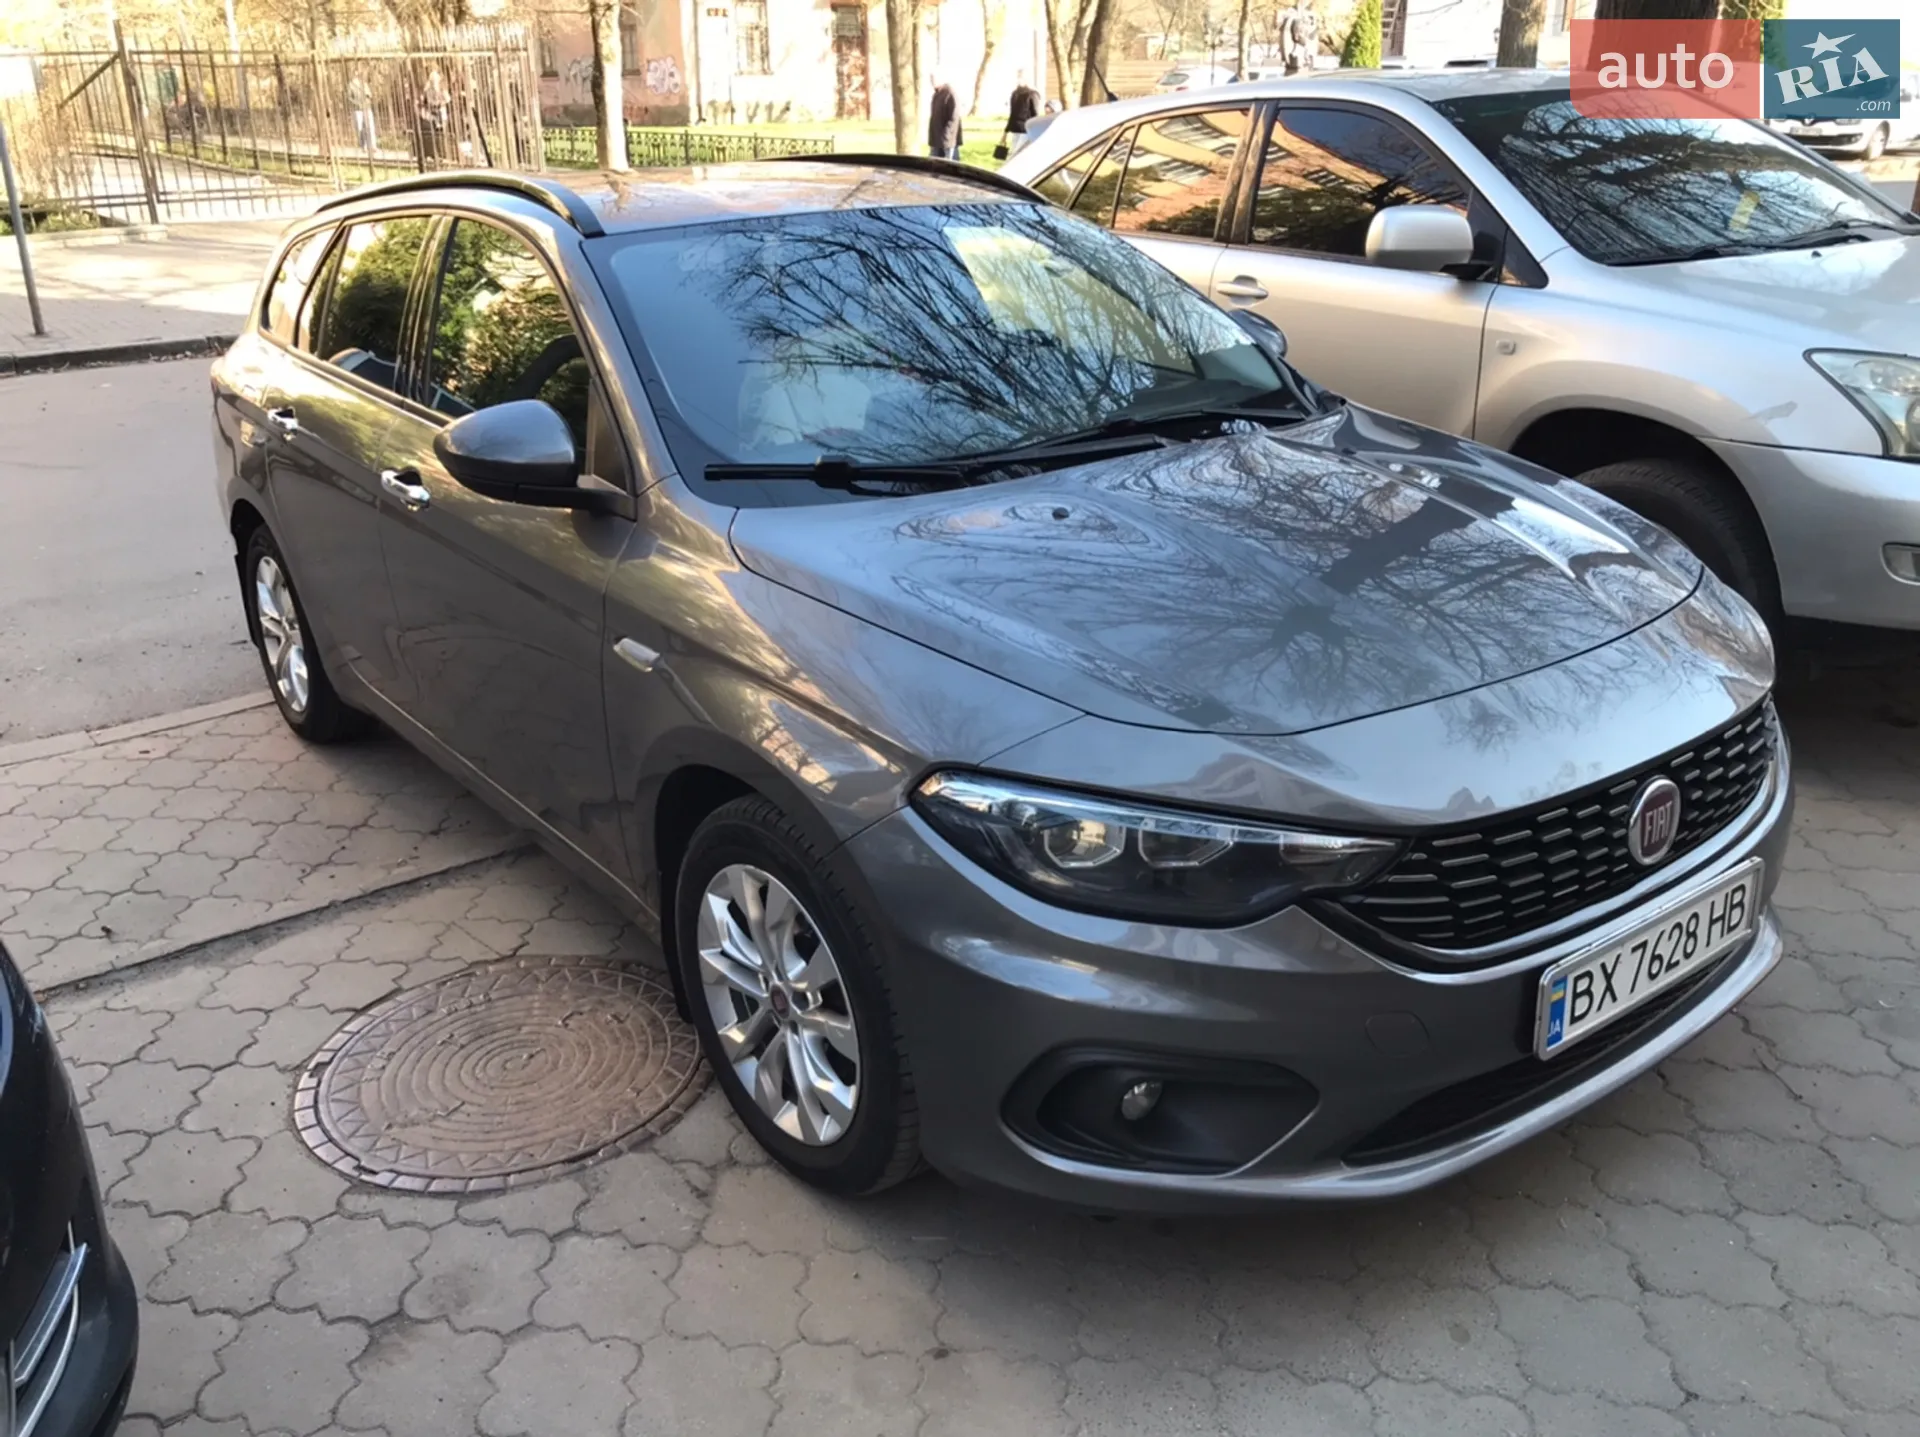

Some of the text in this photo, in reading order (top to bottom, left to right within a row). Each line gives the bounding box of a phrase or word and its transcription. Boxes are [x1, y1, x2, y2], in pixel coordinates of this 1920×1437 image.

[1643, 800, 1672, 847] FIAT
[1569, 883, 1746, 1025] BX 7628 HB
